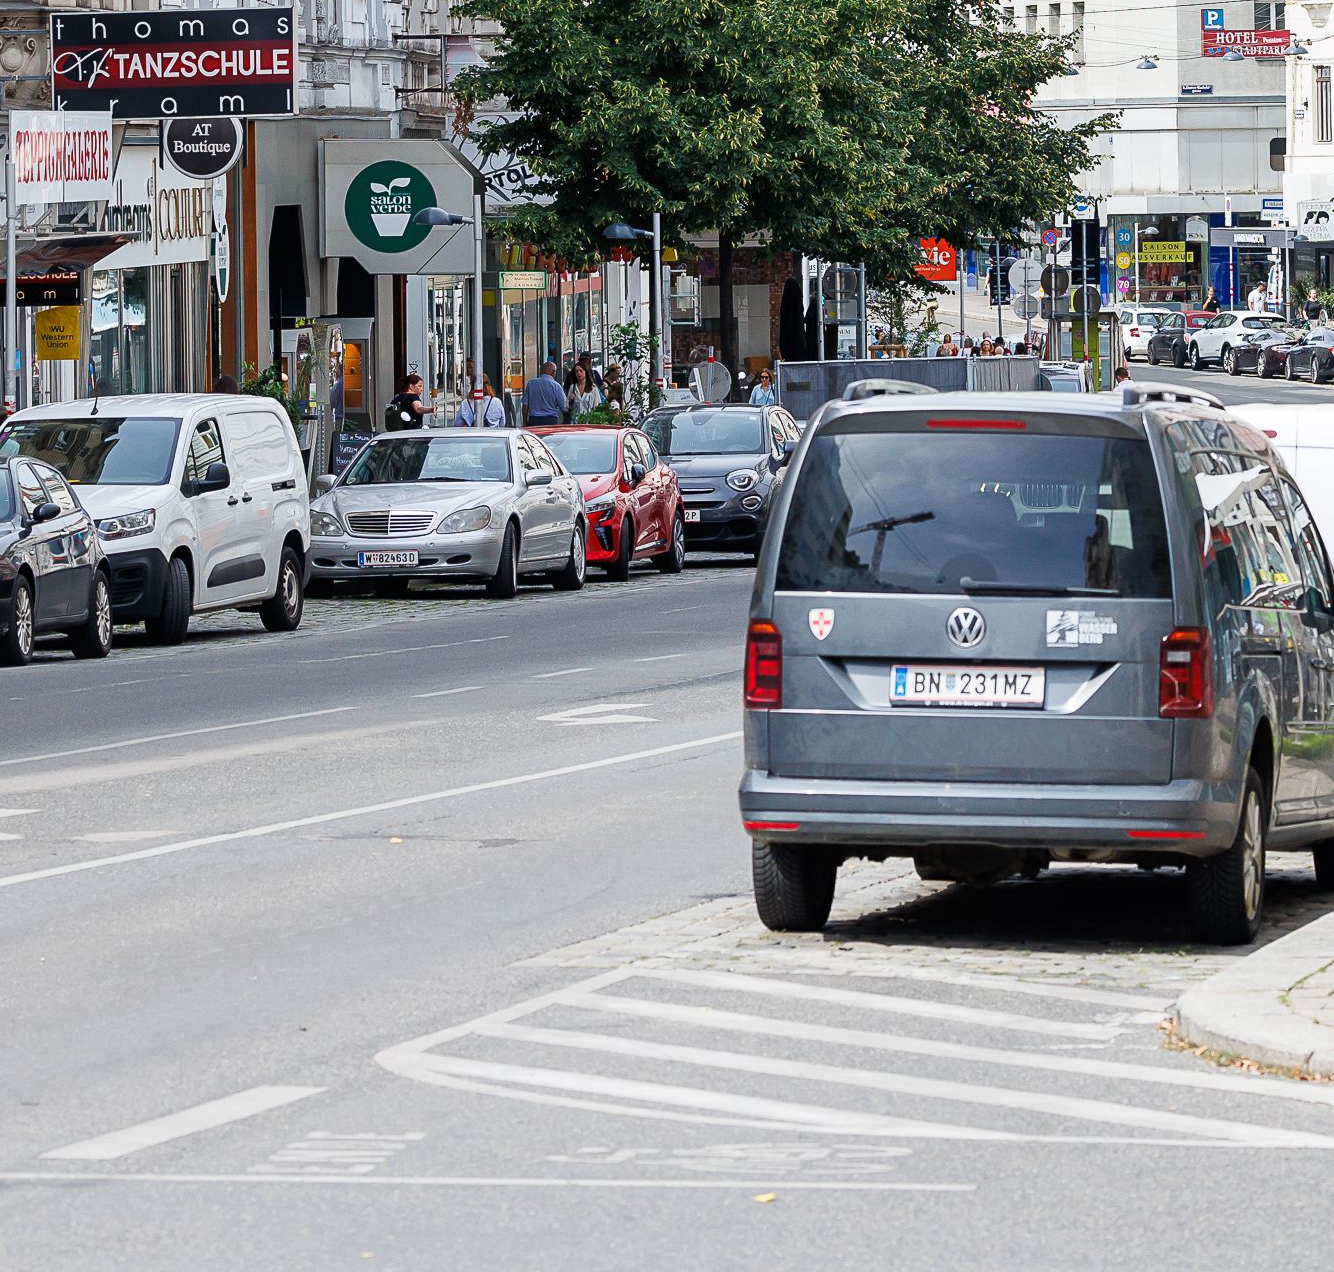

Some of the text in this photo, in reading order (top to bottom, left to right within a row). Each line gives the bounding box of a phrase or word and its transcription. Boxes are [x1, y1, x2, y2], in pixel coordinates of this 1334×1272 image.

[1207, 11, 1219, 26] P
[1216, 32, 1258, 44] HOTEL
[114, 49, 289, 78] TANZSCHULE
[192, 124, 211, 136] AT
[174, 140, 231, 155] Boutique
[16, 130, 109, 183] TEPPICHGALERIE
[1118, 232, 1130, 241] 30
[1119, 255, 1129, 264] 50
[1118, 279, 1130, 288] 70
[914, 672, 941, 694] BN
